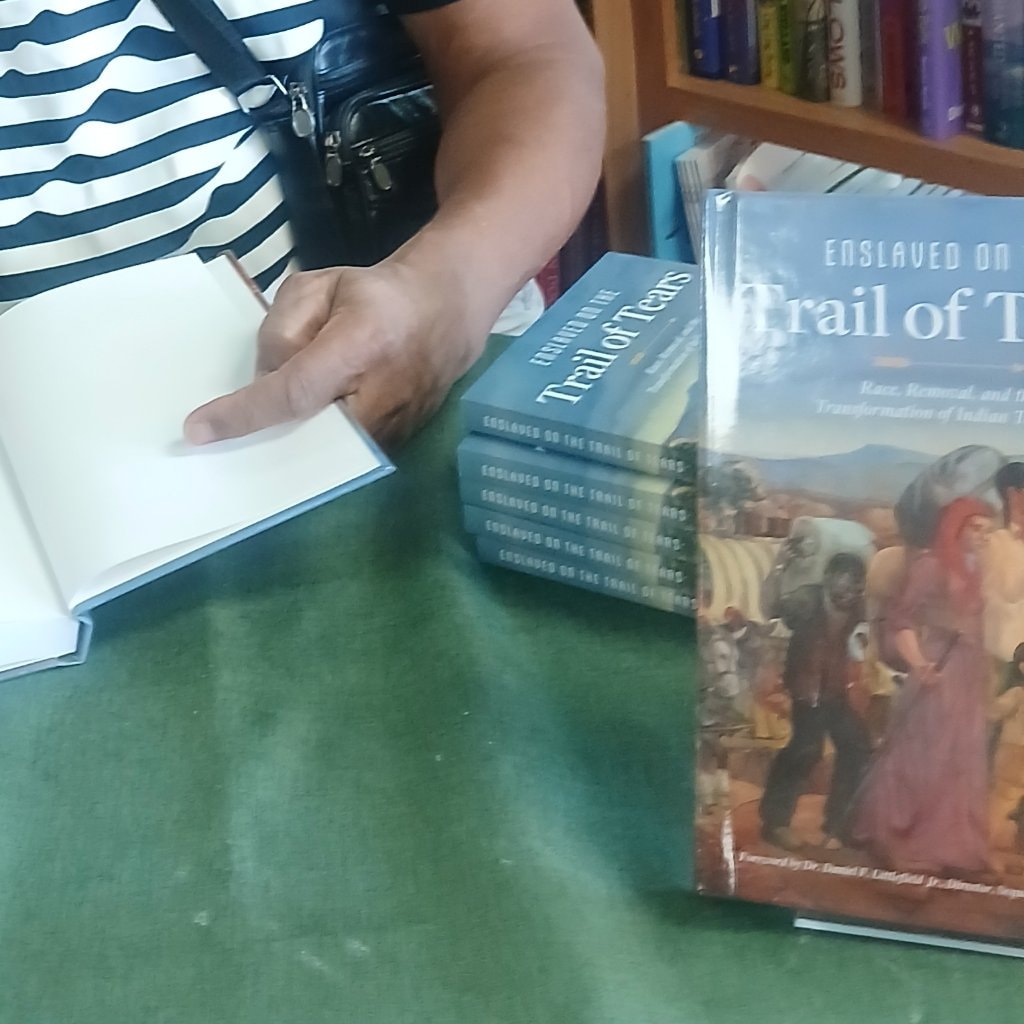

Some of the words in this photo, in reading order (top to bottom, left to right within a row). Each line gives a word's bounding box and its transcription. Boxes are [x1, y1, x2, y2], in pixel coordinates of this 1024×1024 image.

[825, 238, 961, 271] ENSLAVED
[976, 242, 1010, 271] ON
[621, 269, 693, 324] Tears
[738, 283, 891, 338] Trail
[904, 287, 975, 341] of
[530, 318, 586, 367] ENSLAVED
[594, 288, 622, 311] THE
[603, 321, 640, 351] of
[536, 347, 619, 405] Trail
[980, 387, 1011, 402] and
[816, 398, 933, 422] Transformation
[936, 405, 955, 423] of
[956, 407, 1009, 424] Indian
[481, 415, 541, 439] ENSLAVED
[542, 429, 560, 443] ON
[563, 434, 586, 450] THE
[586, 440, 623, 458] TRAIL
[480, 463, 540, 487] ENSLAVED
[542, 478, 560, 491] ON
[563, 483, 586, 498] THE
[588, 489, 624, 506] TRAIL
[480, 489, 539, 514] ENSLAVED
[540, 503, 558, 518] ON
[559, 508, 582, 525] THE
[584, 515, 620, 534] TRAIL
